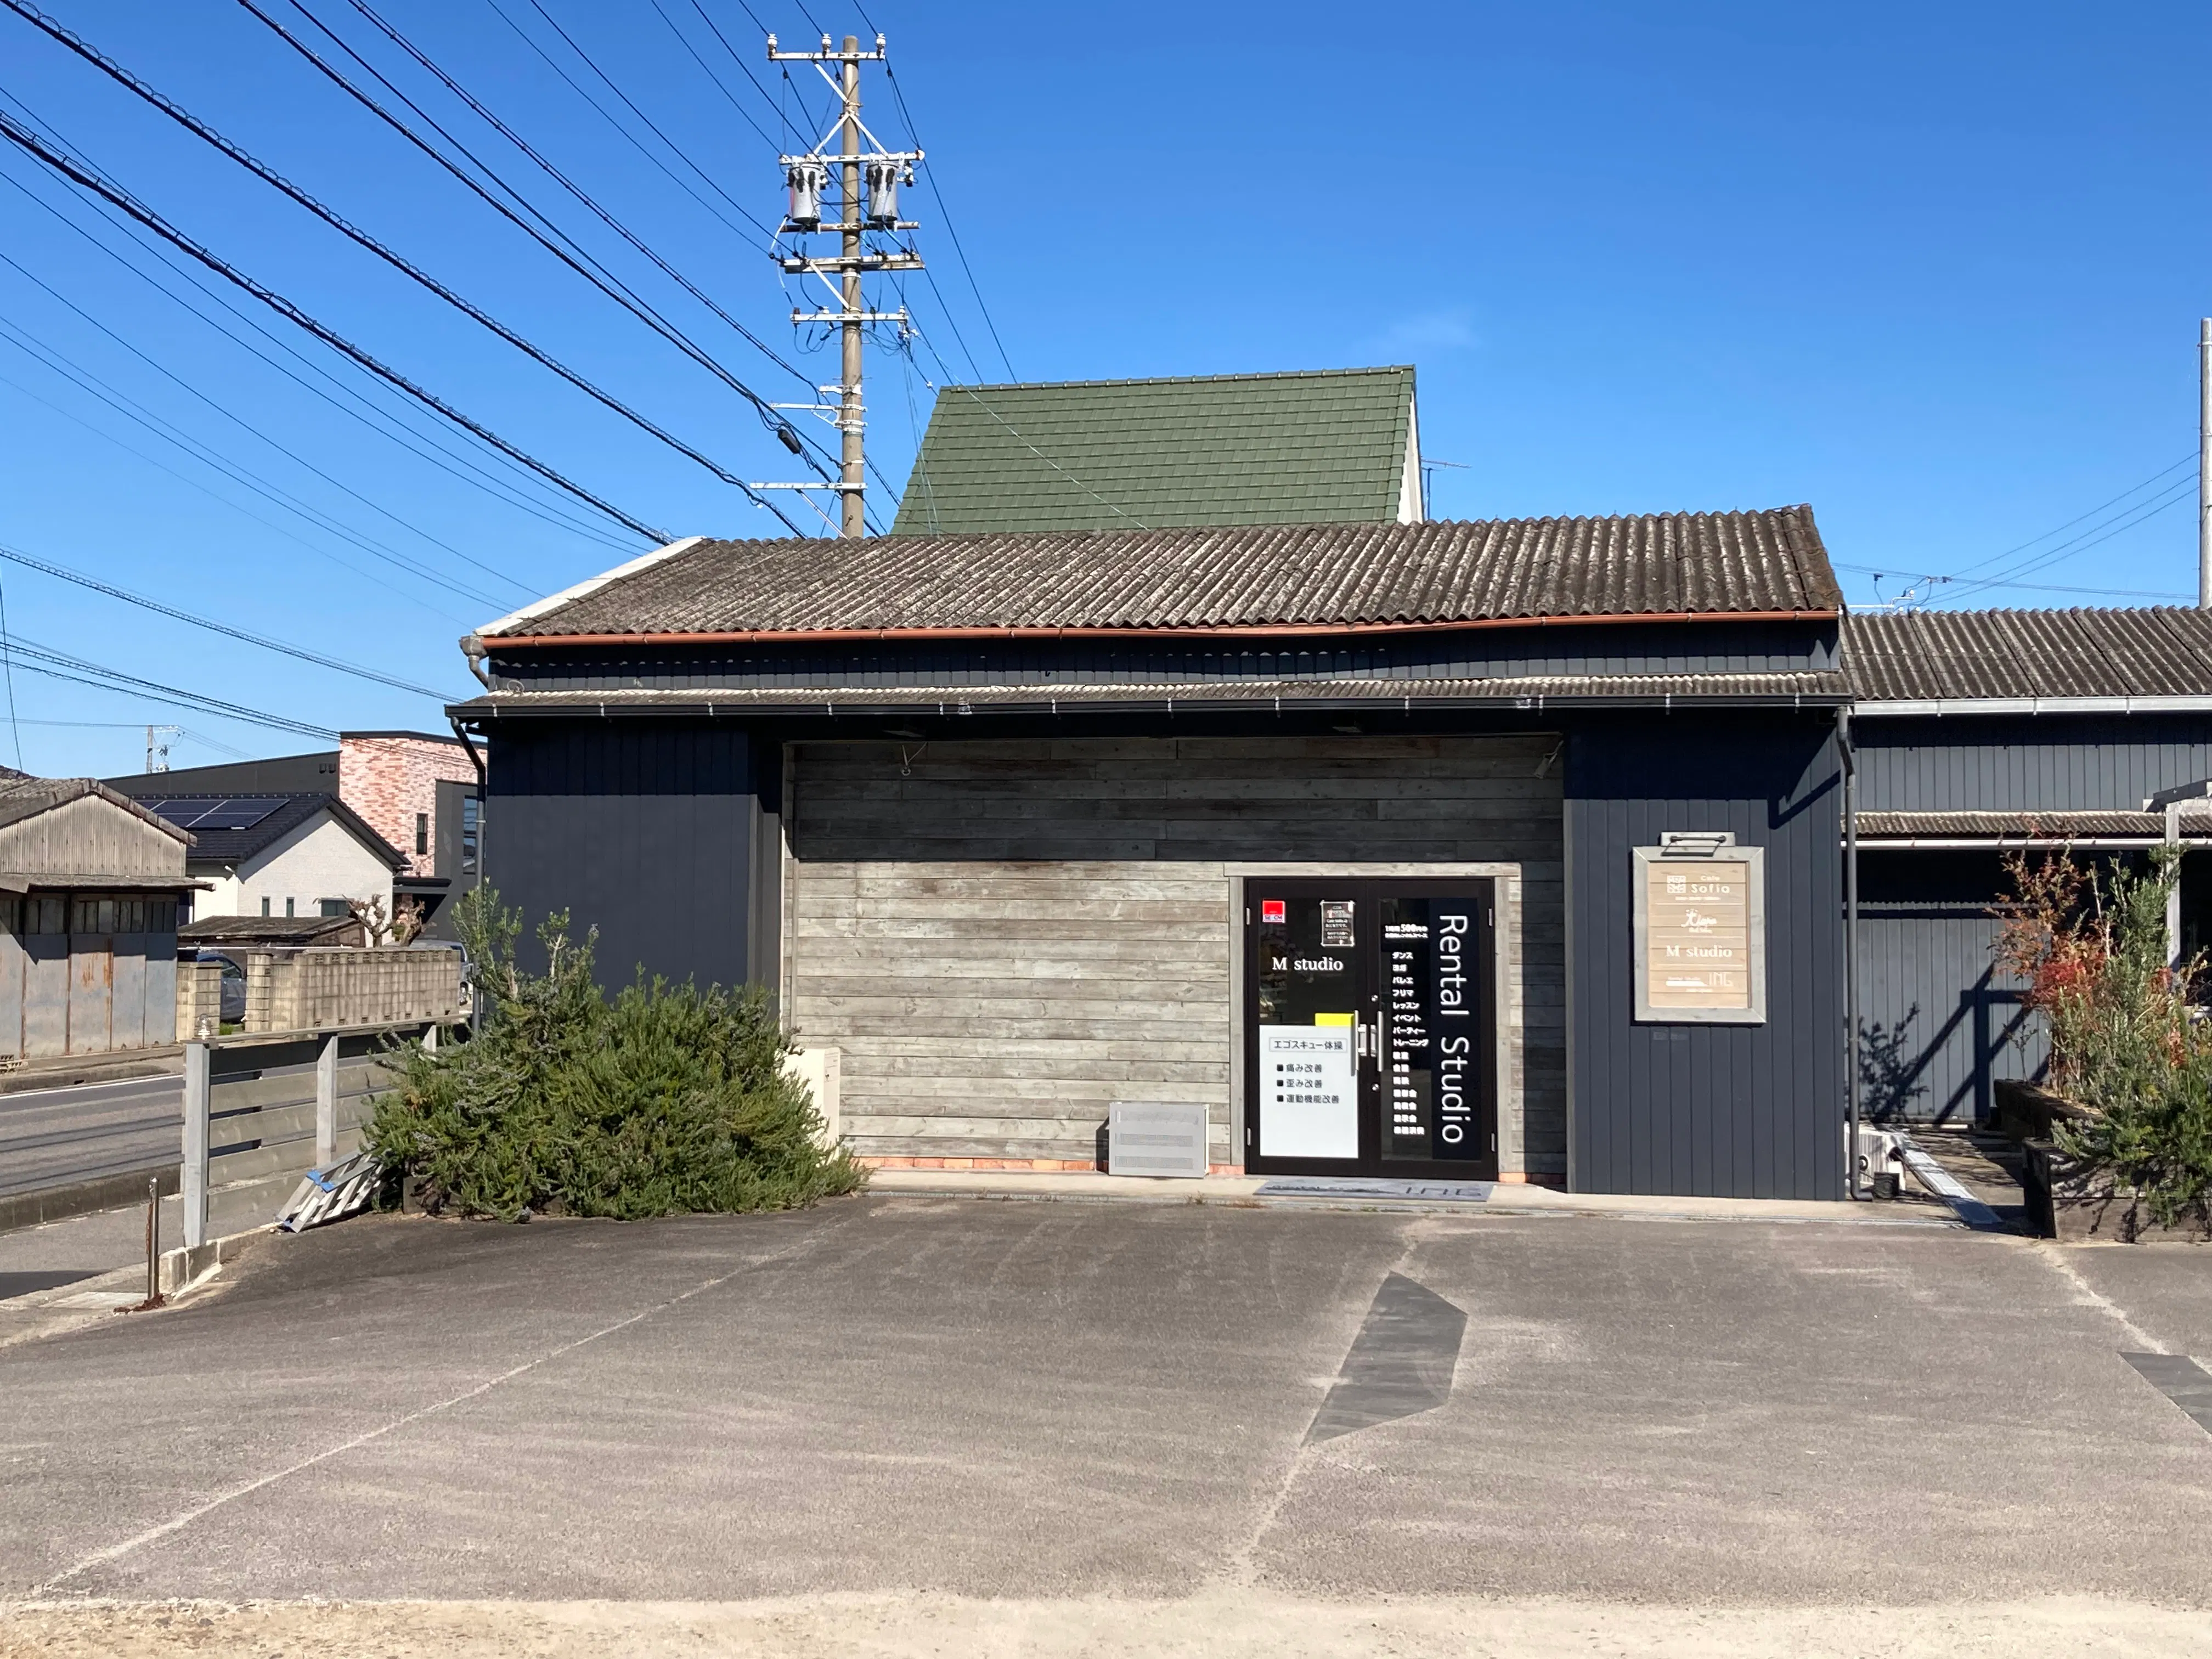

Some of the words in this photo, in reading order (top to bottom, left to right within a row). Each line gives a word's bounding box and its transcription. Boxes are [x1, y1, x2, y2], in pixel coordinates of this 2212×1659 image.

[1690, 883, 1730, 894] Sofia
[1392, 951, 1414, 960] ダンス
[1666, 945, 1680, 957] M
[1686, 945, 1733, 957] studio
[1272, 957, 1288, 970] M
[1294, 956, 1344, 970] studio
[1439, 915, 1470, 1015] Rental
[1392, 1001, 1420, 1009] レッスン
[1441, 1036, 1471, 1143] Studio
